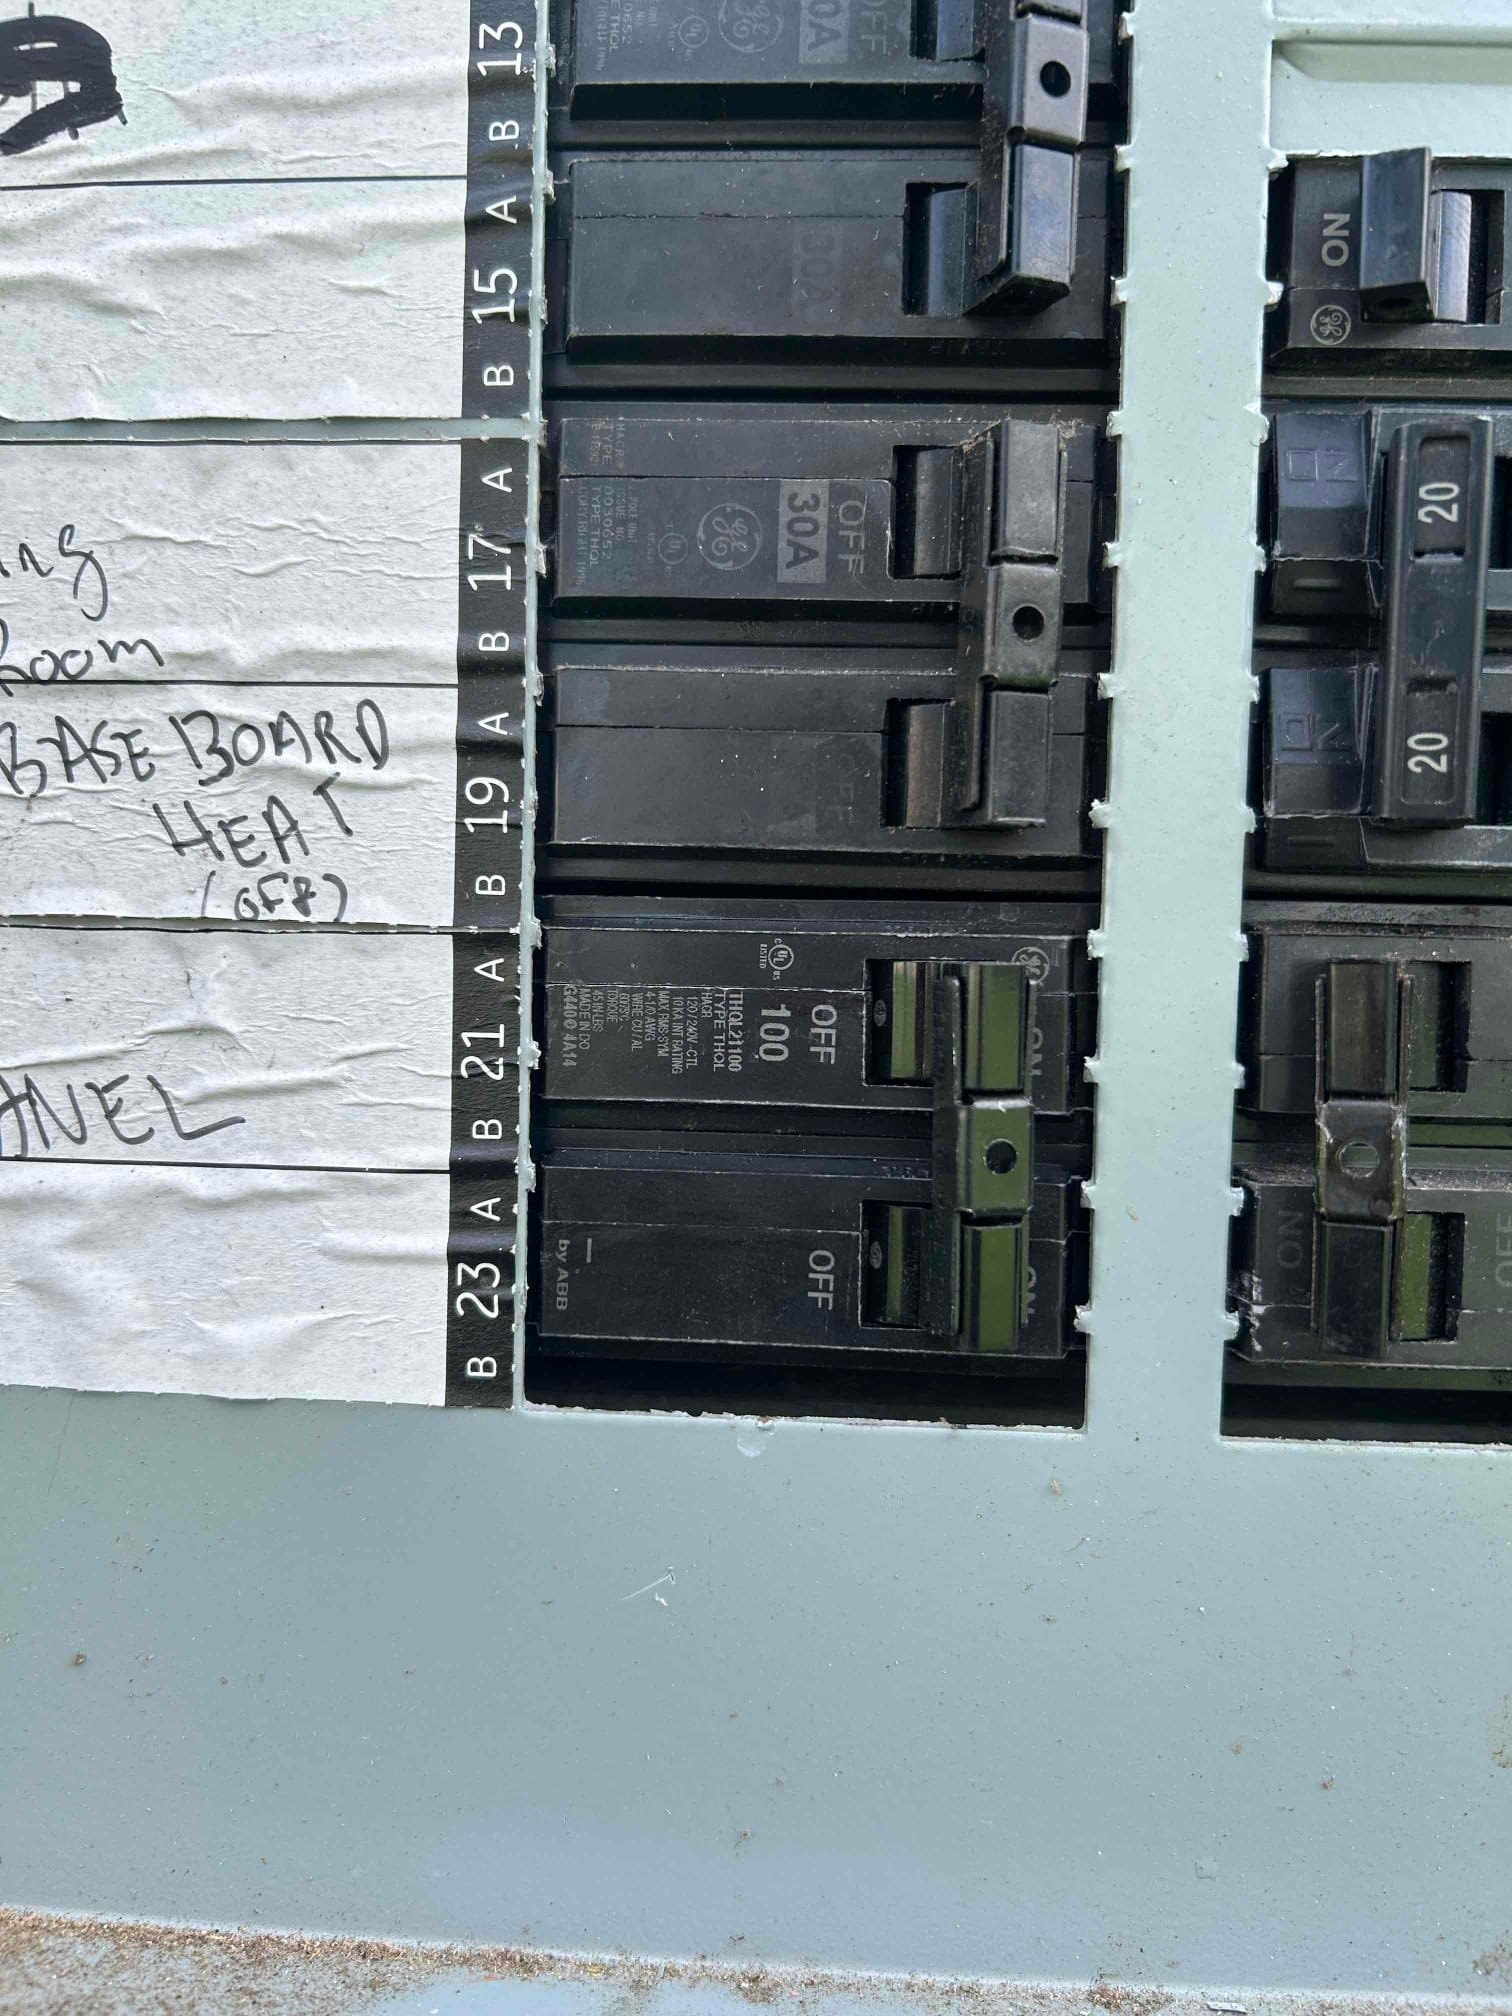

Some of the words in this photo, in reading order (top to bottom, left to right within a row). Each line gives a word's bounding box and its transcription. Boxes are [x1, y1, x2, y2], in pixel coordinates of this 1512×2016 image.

[609, 13, 620, 56] THQL
[861, 0, 887, 55] FF
[477, 22, 523, 76] 13
[489, 120, 519, 141] B
[485, 195, 516, 223] A
[1321, 213, 1350, 267] ON
[471, 267, 517, 324] 15
[483, 365, 514, 386] B
[602, 423, 614, 465] TYPE
[482, 468, 512, 492] A
[590, 485, 602, 525] TYPE
[1418, 481, 1460, 524] 20
[589, 527, 601, 569] THQL
[786, 491, 820, 570] 30A
[837, 500, 865, 575] OFF
[467, 532, 512, 591] 17
[478, 631, 510, 652] B
[478, 713, 509, 735] A
[1408, 732, 1450, 774] 20
[152, 772, 354, 868] HEAT
[464, 777, 509, 833] 19
[475, 875, 505, 896] B
[474, 958, 504, 981] A
[759, 943, 768, 969] LISTED
[579, 989, 590, 1018] MADE
[592, 990, 603, 1001] 45
[606, 989, 618, 1023] TORQUE
[632, 993, 643, 1016] WIRE
[658, 991, 669, 1010] MAX
[672, 996, 683, 1006] 10
[701, 992, 712, 1018] HACR
[713, 992, 726, 1029] TYPE
[579, 1021, 590, 1030] IN
[644, 1017, 655, 1041] AWG
[672, 1008, 683, 1020] KA
[672, 1023, 683, 1038] INT
[728, 991, 744, 1072] THQL21100
[562, 1033, 577, 1066] 4A14
[758, 1003, 792, 1062] 100
[809, 1004, 838, 1065] OFF
[461, 1024, 504, 1080] 21
[671, 1040, 683, 1075] RATING
[713, 1033, 726, 1072] THQL
[472, 1119, 502, 1139] B
[470, 1198, 500, 1221] A
[555, 1239, 571, 1264] by
[1276, 1209, 1304, 1269] ON
[456, 1263, 500, 1318] 23
[556, 1266, 569, 1311] ABB
[808, 1249, 836, 1311] OFF
[467, 1357, 496, 1377] B
